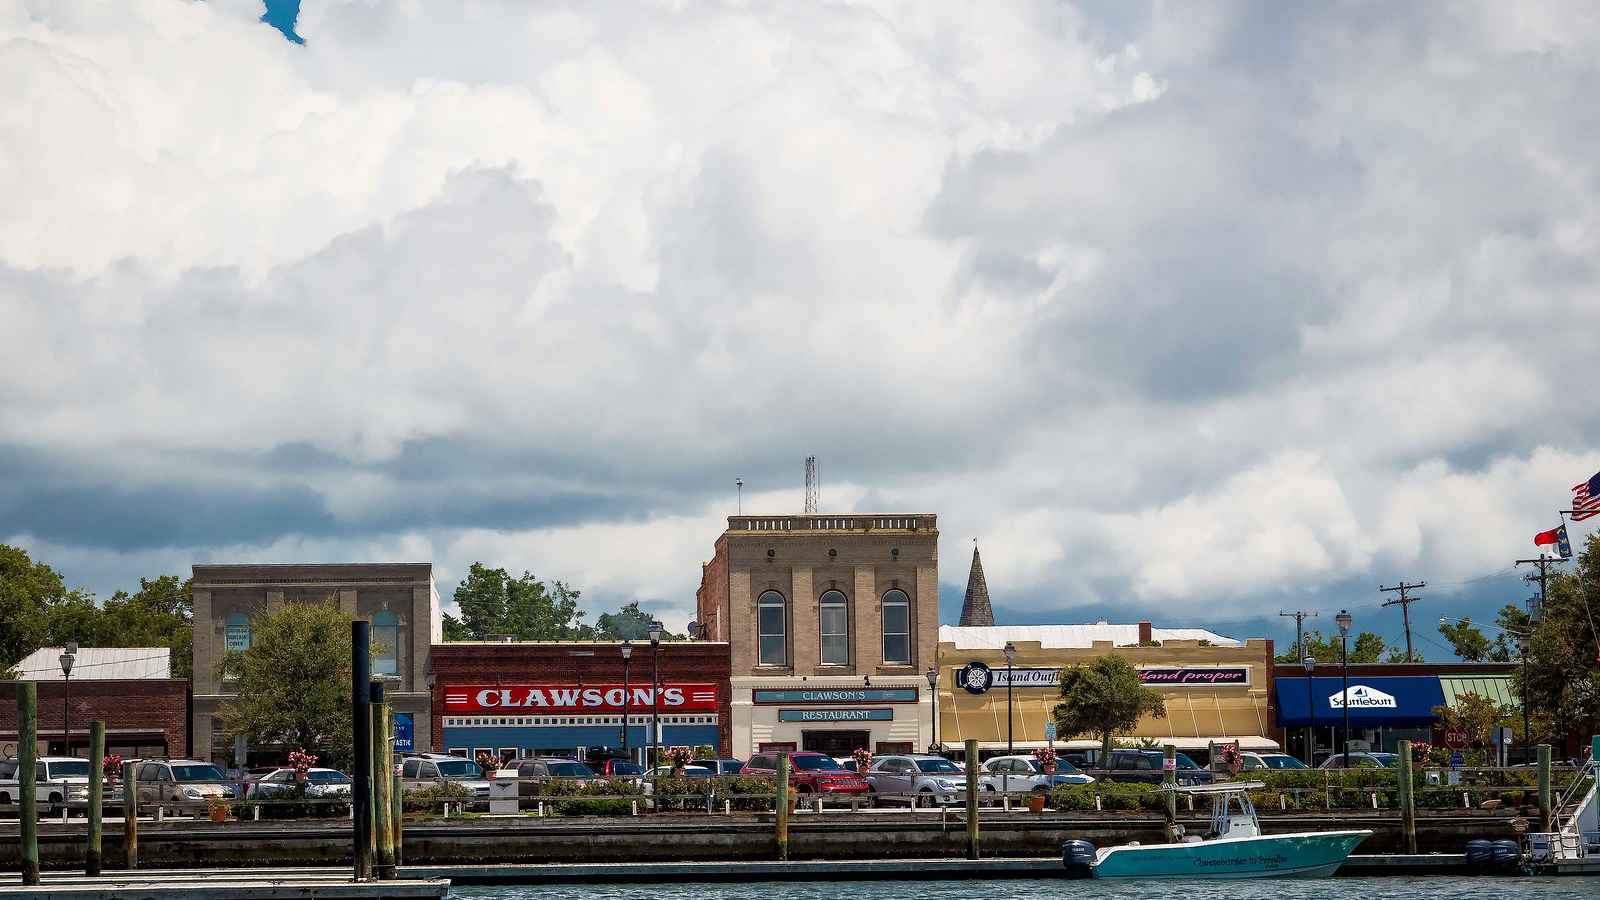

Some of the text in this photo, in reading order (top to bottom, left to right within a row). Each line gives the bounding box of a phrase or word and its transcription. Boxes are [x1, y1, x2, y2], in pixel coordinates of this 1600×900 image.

[996, 670, 1060, 684] Island Outfi
[1137, 670, 1241, 684] land proper
[475, 688, 684, 707] CLAWSON'S
[802, 691, 866, 700] CLAWSON'S
[1332, 697, 1392, 706] Scuttlebutt
[802, 711, 871, 720] RESTAURANT
[1447, 732, 1467, 742] STOP
